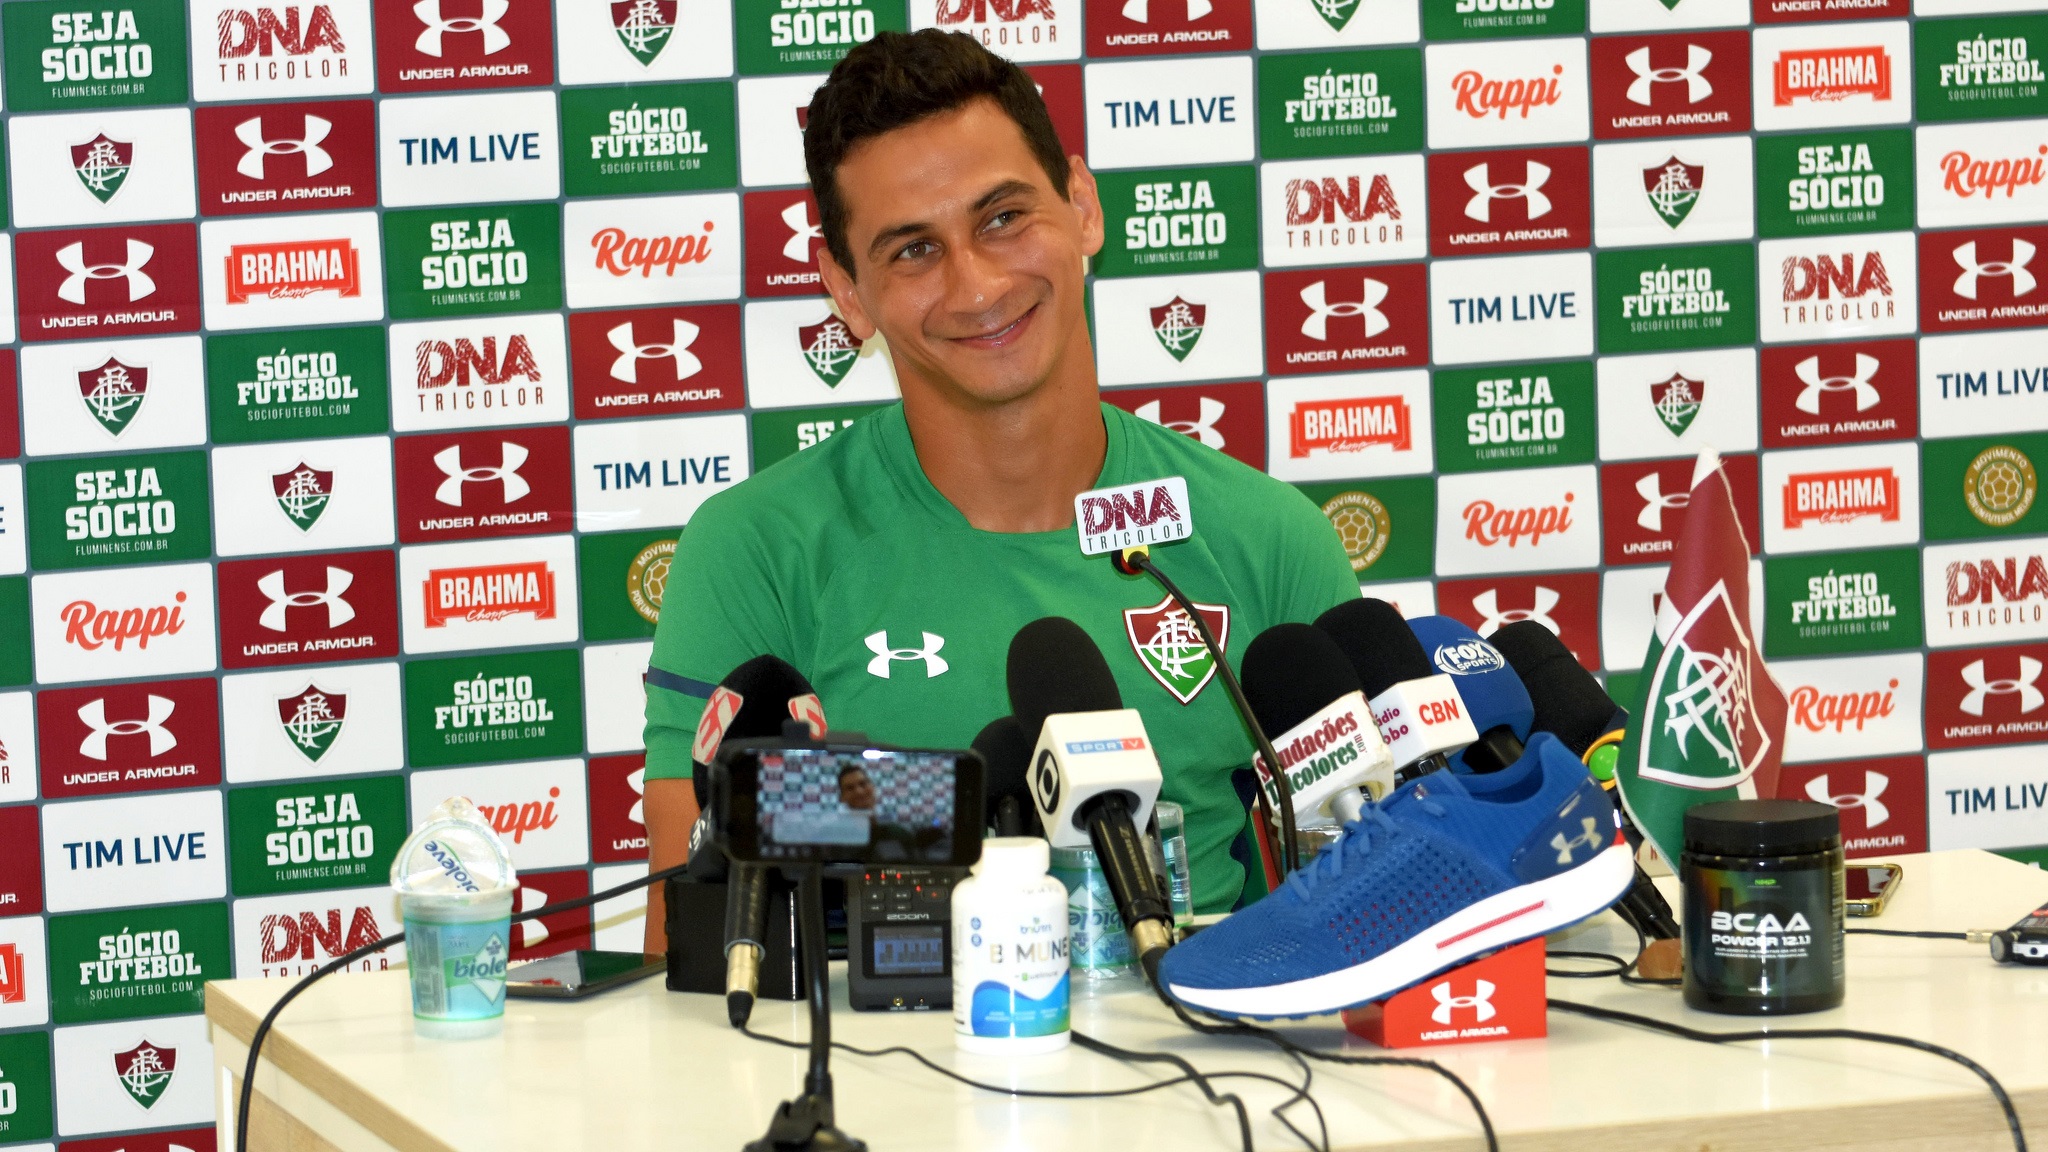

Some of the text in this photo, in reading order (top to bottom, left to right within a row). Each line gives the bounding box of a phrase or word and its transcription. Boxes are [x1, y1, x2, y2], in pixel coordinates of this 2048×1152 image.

[1463, 13, 1547, 28] FLUMINENSE.COM.BR
[1772, 2, 1821, 12] UNDER
[51, 10, 140, 44] SEJA
[217, 4, 346, 60] DNA
[770, 8, 875, 47] SÓCIO
[1105, 29, 1230, 46] UNDER ARMOUR
[780, 49, 849, 62] FLUMINENSE.CO
[1957, 33, 2027, 63] SÓCIO
[41, 42, 153, 83] SÓCIO
[219, 58, 348, 83] TRICOLOR
[399, 64, 529, 81] UNDER ARMOUR
[1787, 55, 1878, 89] BRAHMA
[1939, 61, 2044, 88] FUTEBOL
[51, 83, 145, 99] FLUMINENSE.COM.BR
[1303, 69, 1377, 99] SÓCIO
[1451, 64, 1563, 120] Rappi
[1947, 85, 2038, 101] SOCIOFUTEBOL.COM
[609, 103, 688, 134] SÓCIO
[1104, 96, 1236, 129] TIM LIVE
[1285, 96, 1397, 123] FUTEBOL
[1612, 111, 1729, 128] UNDER ARMOUR
[591, 130, 707, 158] FUTEBOL
[1293, 122, 1389, 138] SOCIOFUTEBOL.COM
[398, 132, 541, 166] TIM LIVE
[1798, 143, 1874, 175] SEJA
[600, 158, 701, 175] SOCIOFUTEBOL.COM
[1940, 144, 2048, 200] Rappi
[221, 185, 352, 204] UNDER ARMOUR
[1134, 180, 1215, 213] SEJA
[1285, 174, 1402, 226] DNA
[1788, 173, 1884, 211] SÓCIO
[1125, 211, 1227, 250] SÓCIO
[1796, 210, 1877, 225] FLUMINENSE.COM.BR
[430, 218, 515, 252] SEJA
[591, 220, 715, 278] Rappi
[1286, 224, 1403, 248] TRICOLOR
[1449, 227, 1568, 245] UNDER ARMOUR
[241, 248, 345, 286] BRAHMA
[421, 251, 528, 290] SÓCIO
[1133, 249, 1219, 265] FLUMINENSE.COM.BR
[766, 273, 820, 285] UNDER
[1639, 263, 1711, 293] SÓCIO
[1782, 251, 1893, 302] DNA
[431, 289, 521, 306] FLUMINENSE.COM.BR
[1448, 291, 1576, 325] TIM LIVE
[1621, 289, 1729, 317] FUTEBOL
[41, 310, 175, 329] UNDER ARMOUR
[1630, 316, 1723, 333] SOCIOFUTEBOL.COM
[1783, 300, 1894, 324] TRICOLOR
[1938, 308, 1988, 322] UNDER
[256, 348, 338, 378] SÓCIO
[416, 334, 542, 390] DNA
[1286, 345, 1407, 364] UNDER ARMOUR
[238, 377, 359, 406] FUTEBOL
[417, 386, 544, 412] TRICOLOR
[594, 388, 722, 407] UNDER ARMOUR
[1476, 376, 1554, 409] SEJA
[1936, 371, 1988, 399] TIM
[247, 403, 351, 422] SOCIOFUTEBOL.COM
[1304, 404, 1397, 440] BRAHMA
[1467, 407, 1565, 445] SÓCIO
[1780, 418, 1896, 437] UNDER ARMOUR
[1475, 443, 1558, 460] FLUMINENSE.COM.BR
[1973, 448, 2028, 471] MOVIMENTO
[75, 467, 163, 502] SEJA
[593, 455, 731, 491] TIM LIVE
[1322, 495, 1383, 515] MOVIMENTO
[1797, 476, 1887, 512] BRAHMA
[65, 500, 176, 541] SÓCIO
[419, 511, 549, 531] UNDER ARMOUR
[1082, 484, 1181, 535] DNA
[1462, 492, 1575, 548] Rappi
[75, 539, 168, 556] FLUMINENSE.COM.BR
[1087, 522, 1184, 552] TRICOLOR
[1623, 541, 1671, 553] UNDER
[637, 543, 678, 568] MOVIME
[439, 571, 541, 609] BRAHMA
[1808, 569, 1878, 599] SÓCIO
[1946, 556, 2048, 608] DNA
[60, 591, 187, 652] Rappi
[1792, 595, 1895, 624] FUTEBOL
[1947, 604, 2042, 629] TRICOLO
[1799, 619, 1890, 638] SOCIOFUTEBOL.COM
[243, 636, 374, 656] UNDER ARMOUR
[1444, 640, 1490, 667] FOX
[1456, 655, 1498, 672] SPORTS
[454, 673, 532, 705] SÓCIO
[435, 701, 553, 729] FUTEBOL
[1419, 698, 1460, 727] CBN
[1789, 678, 1899, 733] Rappi
[444, 726, 546, 745] SOCIOFUTEBOL.COM
[1944, 726, 1992, 738] UNDER
[1254, 710, 1359, 784] Sudações
[63, 764, 196, 785] UNDER ARMOUR
[1264, 740, 1359, 806] Ticolores
[275, 793, 361, 828] SEJA
[478, 786, 561, 844] appi
[1945, 787, 1996, 816] TIM
[62, 831, 207, 871] TIM LIVE
[265, 825, 374, 866] SÓCIO
[612, 838, 650, 850] UND
[1844, 834, 1906, 850] ARMOUR
[275, 863, 367, 881] FLUMINENSE.COM.BR
[886, 913, 930, 921] ZOOM
[1710, 910, 1812, 933] BCAA
[99, 928, 180, 960] SÓCIO
[260, 906, 388, 964] DNA
[1711, 933, 1779, 947] POWDER
[80, 953, 202, 986] FUTEBOL
[89, 980, 194, 1001] SOCIOFUTEBOL.COM
[1420, 1025, 1509, 1040] UNDER ARMOUR
